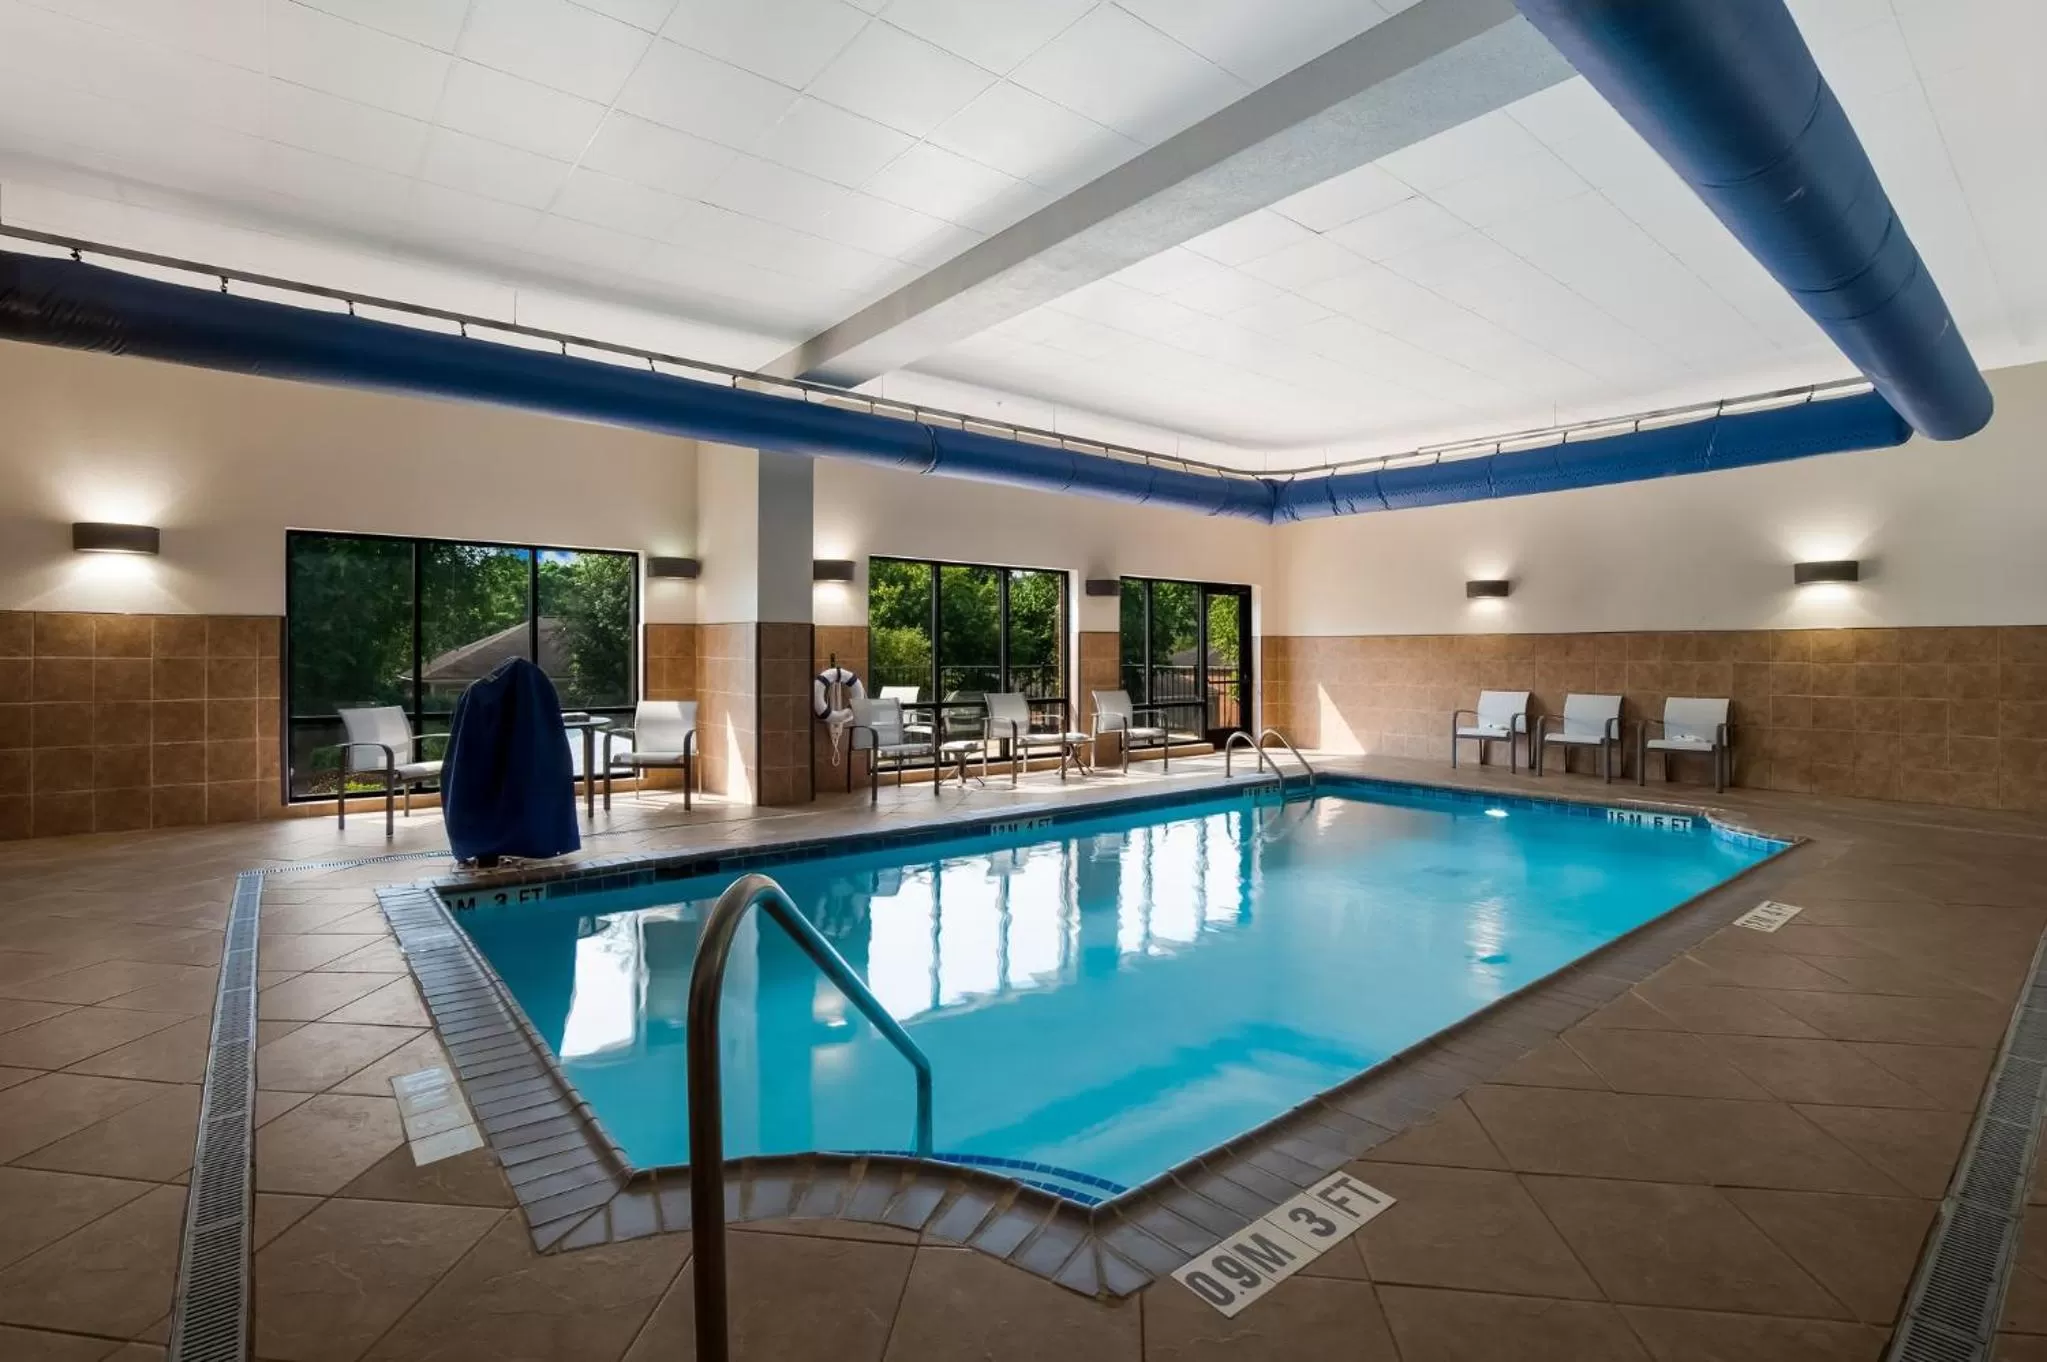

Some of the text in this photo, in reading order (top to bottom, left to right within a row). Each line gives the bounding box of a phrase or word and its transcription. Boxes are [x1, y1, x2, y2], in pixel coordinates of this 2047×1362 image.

[519, 886, 544, 904] FT
[1288, 1207, 1337, 1237] 3
[1316, 1176, 1381, 1219] FT
